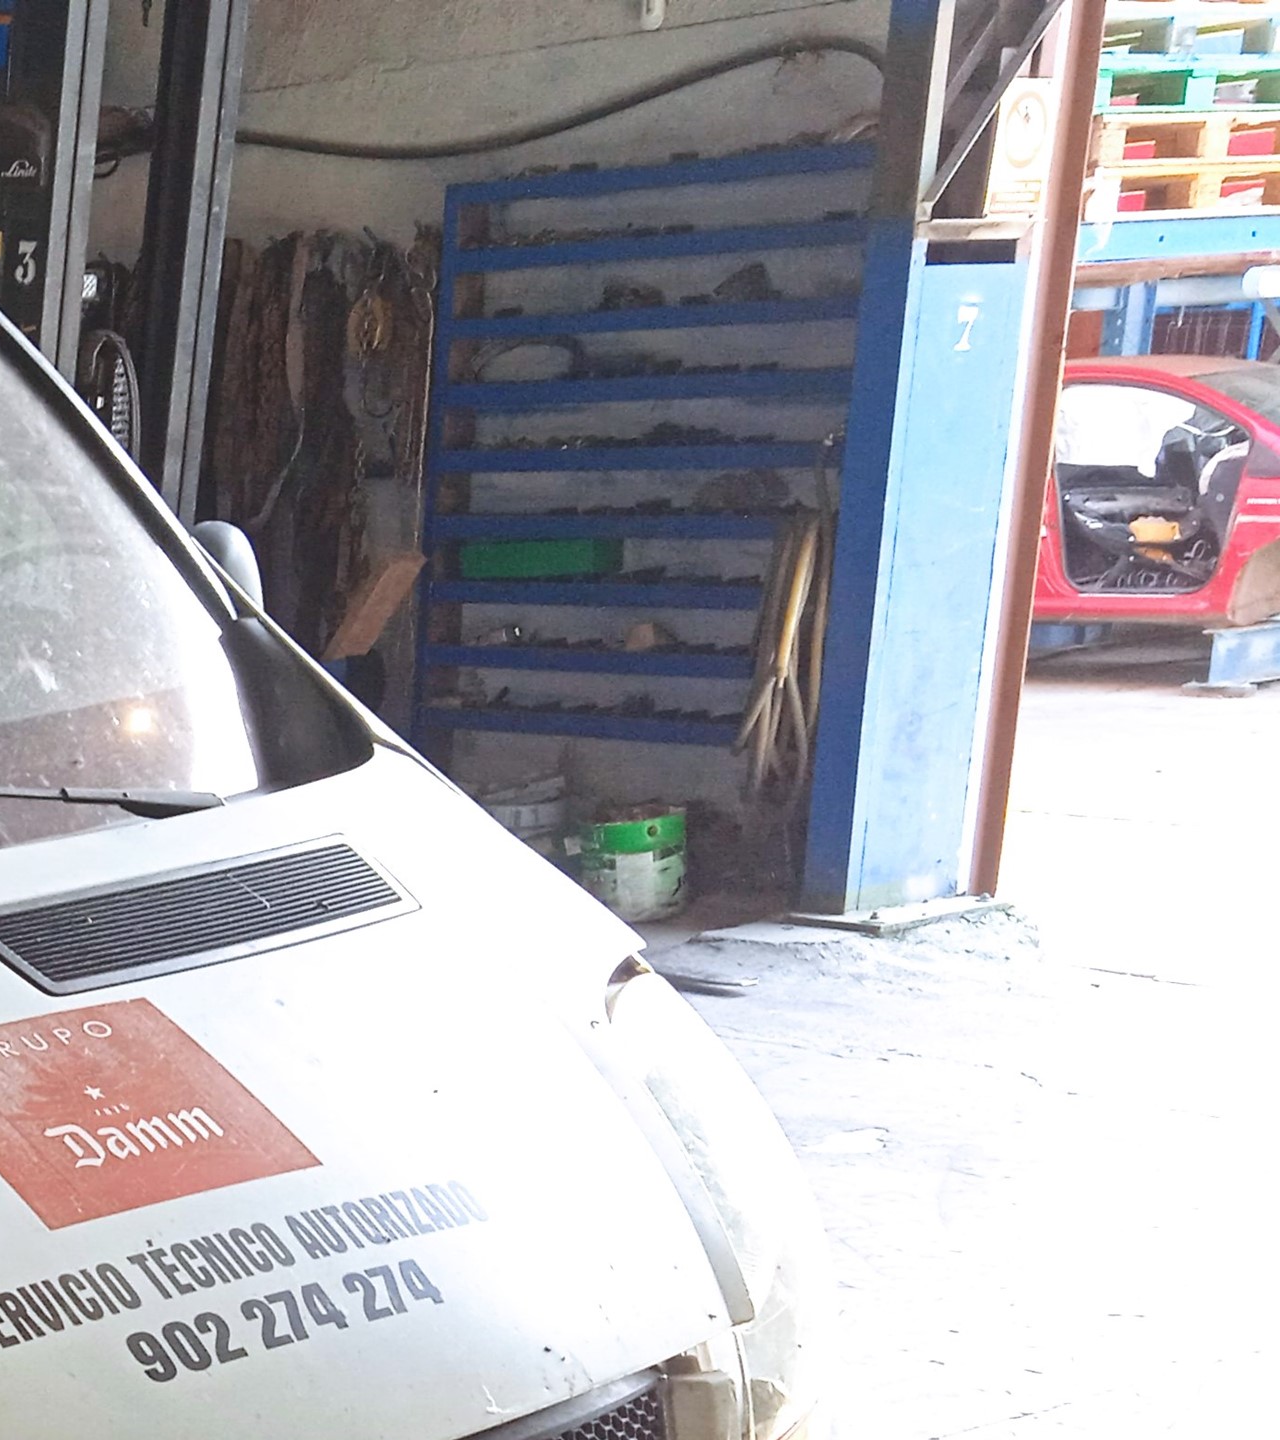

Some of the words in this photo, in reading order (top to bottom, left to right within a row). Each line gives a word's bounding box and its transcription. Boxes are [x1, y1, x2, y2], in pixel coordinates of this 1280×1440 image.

[14, 240, 38, 285] 3
[952, 304, 980, 353] 7
[42, 1105, 225, 1169] Damm
[127, 1221, 297, 1301] TÉCNICO
[284, 1179, 489, 1261] AUTORIZADO
[126, 1310, 248, 1384] 902
[240, 1281, 350, 1351] 274
[342, 1257, 445, 1322] 274
